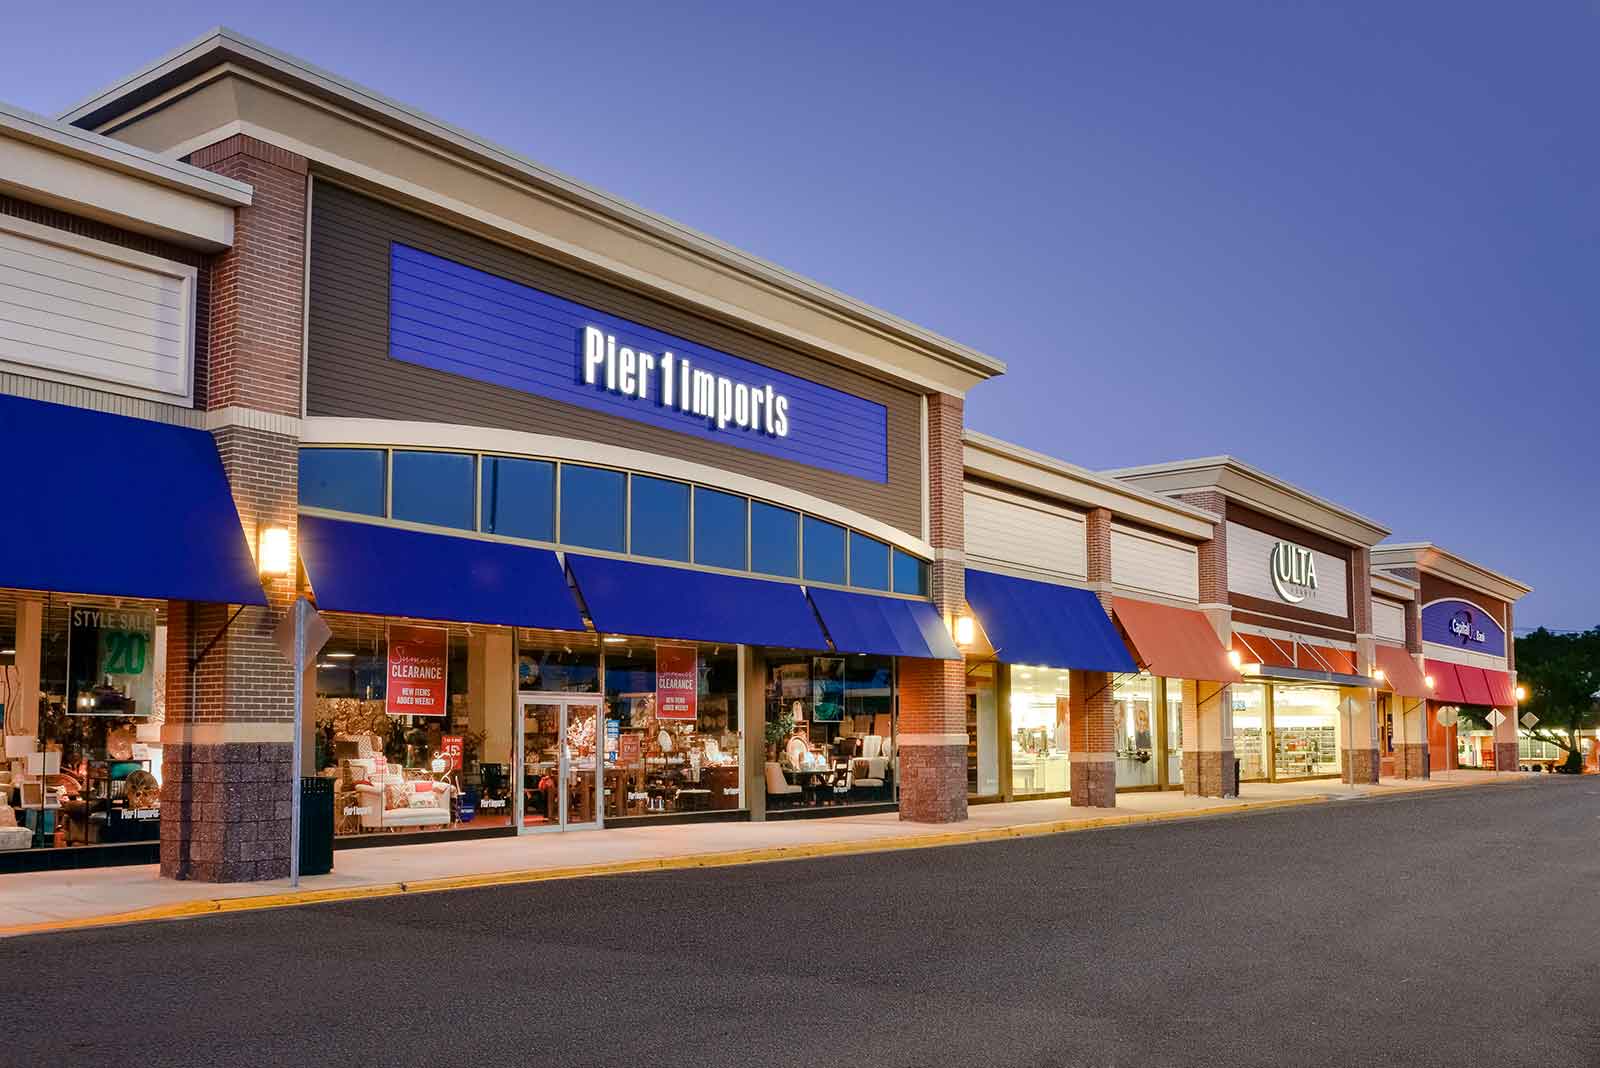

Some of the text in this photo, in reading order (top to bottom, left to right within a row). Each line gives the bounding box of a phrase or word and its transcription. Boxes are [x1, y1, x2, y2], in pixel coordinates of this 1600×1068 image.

[584, 325, 788, 438] Pier 1 imports
[1278, 541, 1319, 588] ULTA
[73, 610, 153, 633] STYLE SALE
[104, 632, 146, 674] 20
[391, 664, 443, 680] CLEARANCE
[658, 678, 694, 690] CLEARANCE
